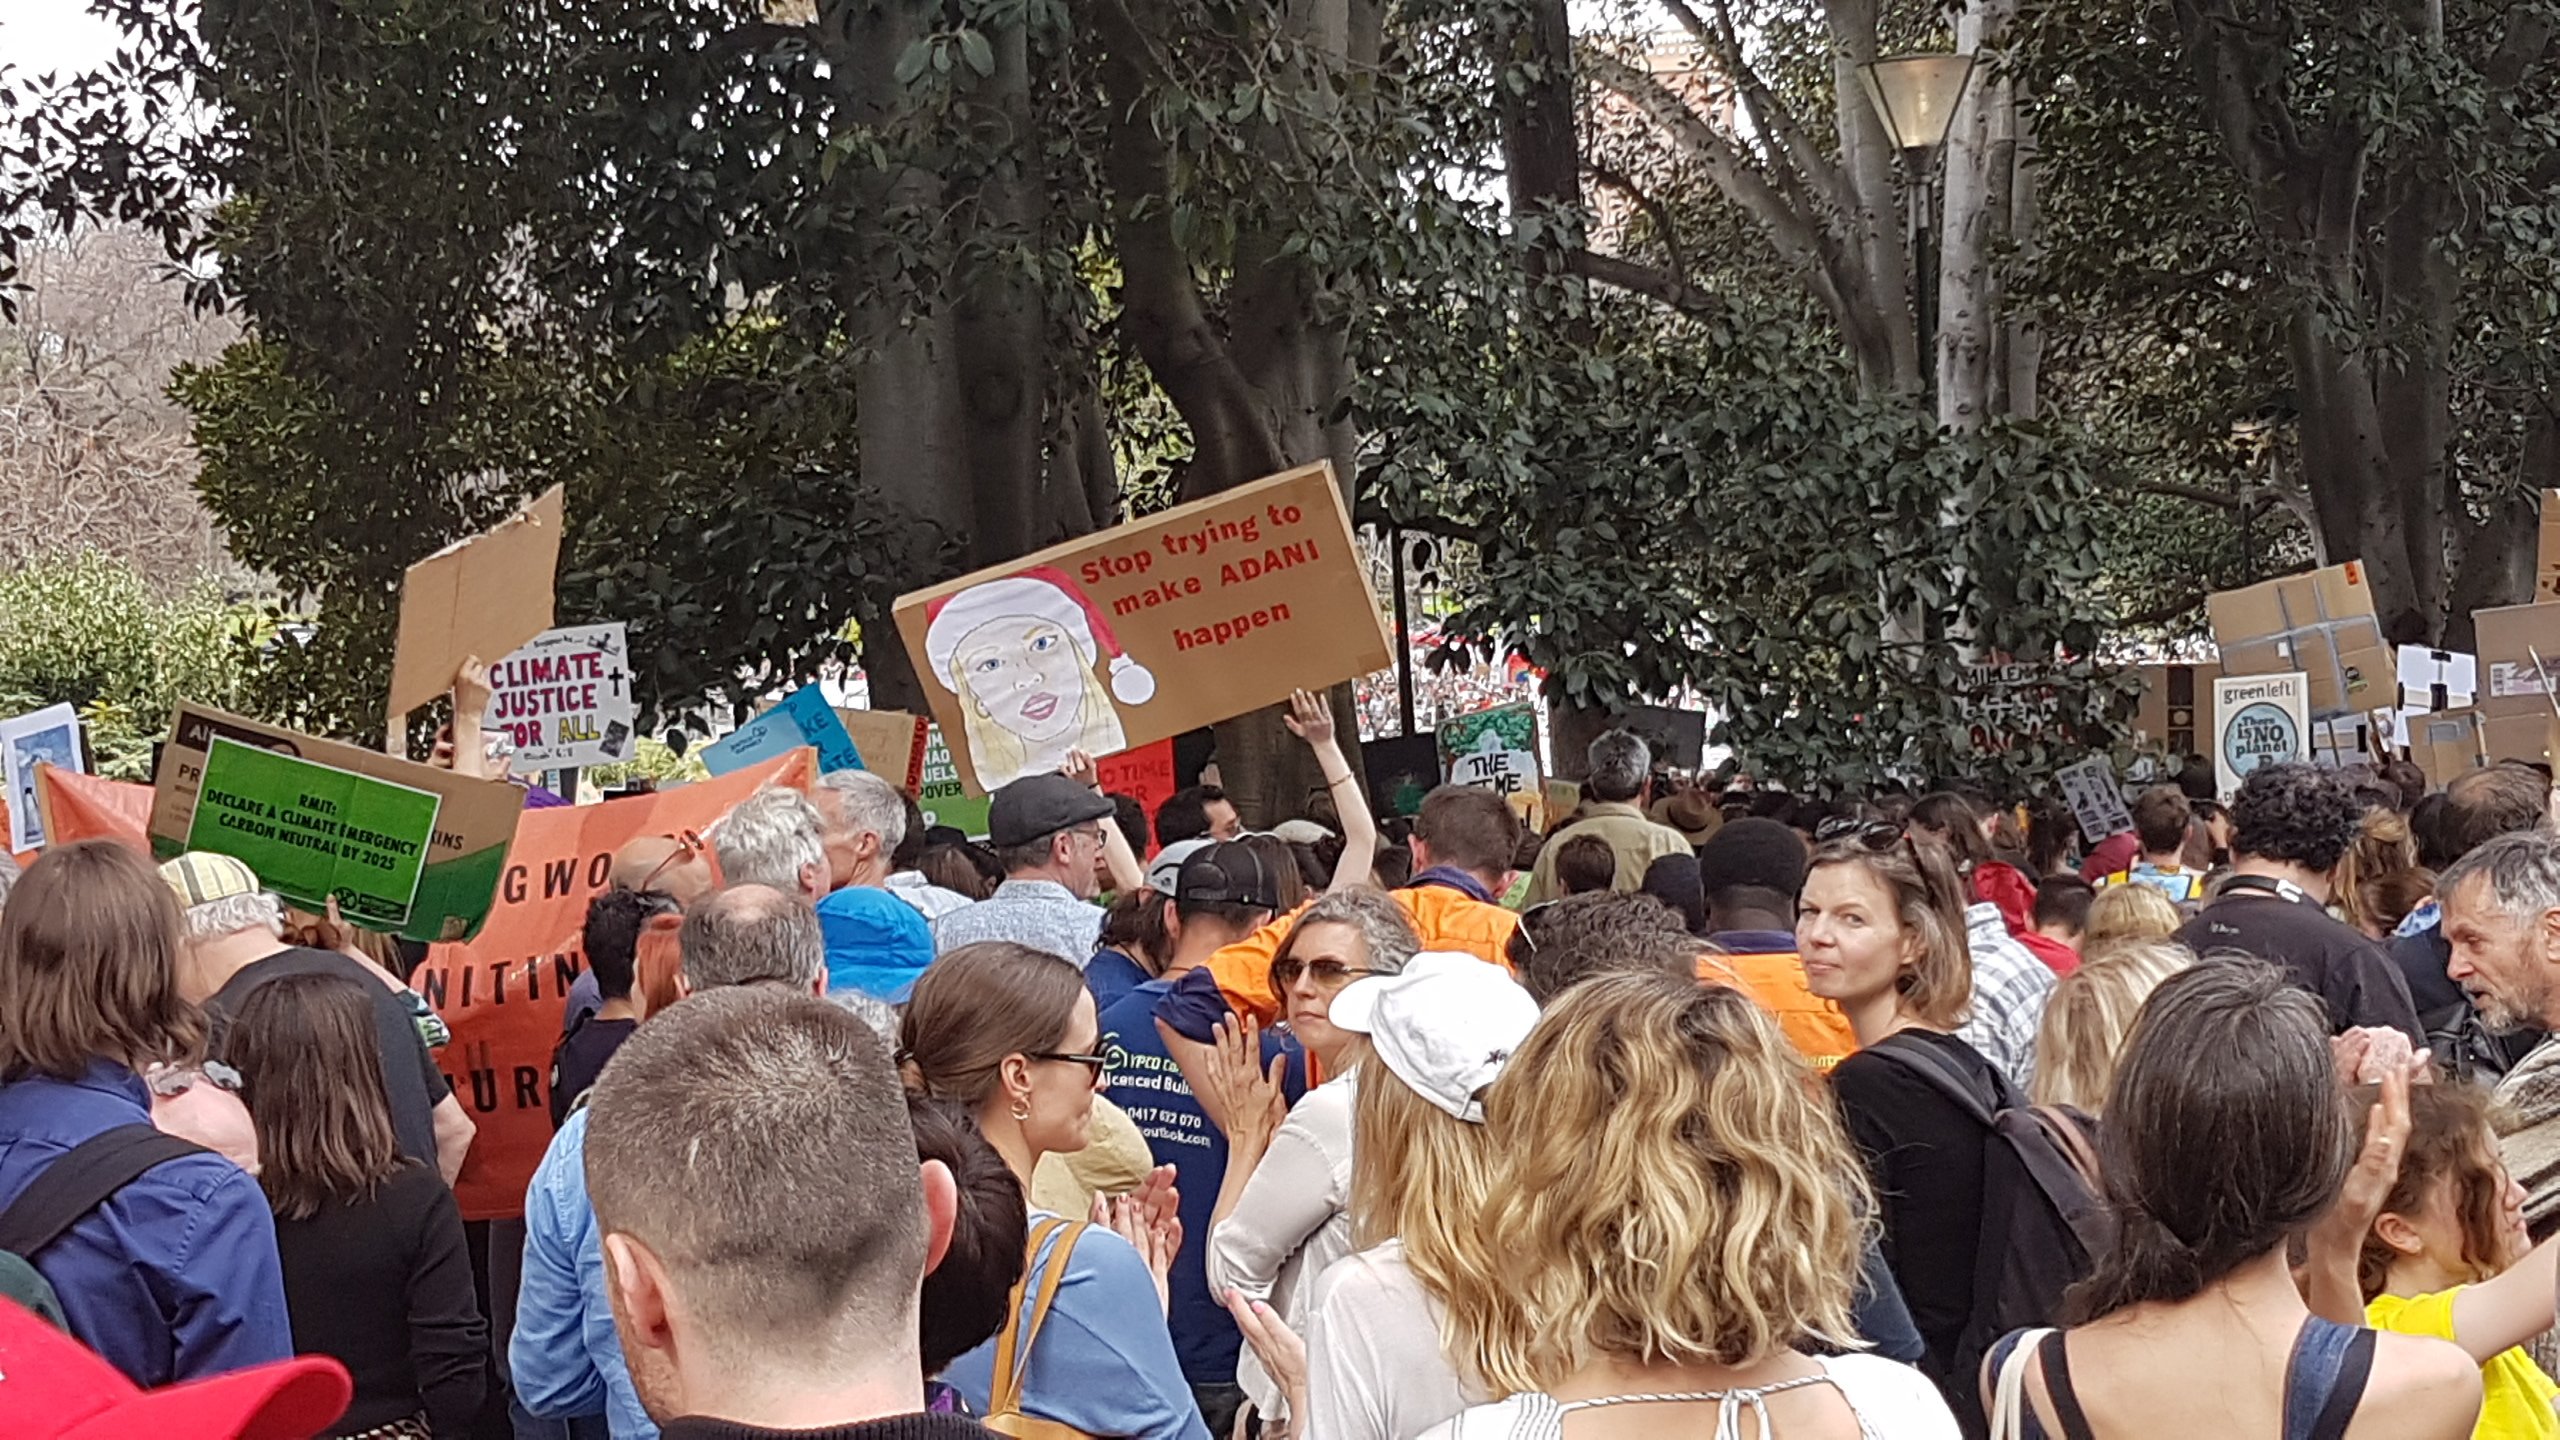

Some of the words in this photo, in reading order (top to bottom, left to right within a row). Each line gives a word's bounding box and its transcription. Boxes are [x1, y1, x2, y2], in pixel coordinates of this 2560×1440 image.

[1080, 547, 1152, 584] Stop
[1161, 517, 1260, 555] trying
[1266, 503, 1301, 526] to
[1112, 575, 1201, 616] make
[1219, 538, 1320, 587] ADANI
[1173, 602, 1291, 651] happen
[489, 651, 604, 690] CLIMATE
[494, 683, 598, 719] JUSTICE
[557, 714, 601, 744] ALL
[2241, 716, 2276, 727] There
[2254, 725, 2284, 743] NO
[2235, 739, 2288, 759] planet
[1120, 760, 1170, 781] TIME
[1468, 753, 1509, 777] THE
[1468, 773, 1522, 798] TME
[299, 793, 337, 816] RMIT:
[206, 788, 265, 817] DECLARE
[266, 805, 277, 820] A
[280, 808, 338, 836] CLIMATE
[338, 822, 419, 858] EMERGENCY
[219, 811, 276, 840] CARBON
[278, 829, 337, 856] NEUTRAL
[340, 844, 362, 862] BY
[361, 850, 397, 871] 2025
[1127, 1106, 1157, 1121] 0417
[1179, 1113, 1202, 1129] 070
